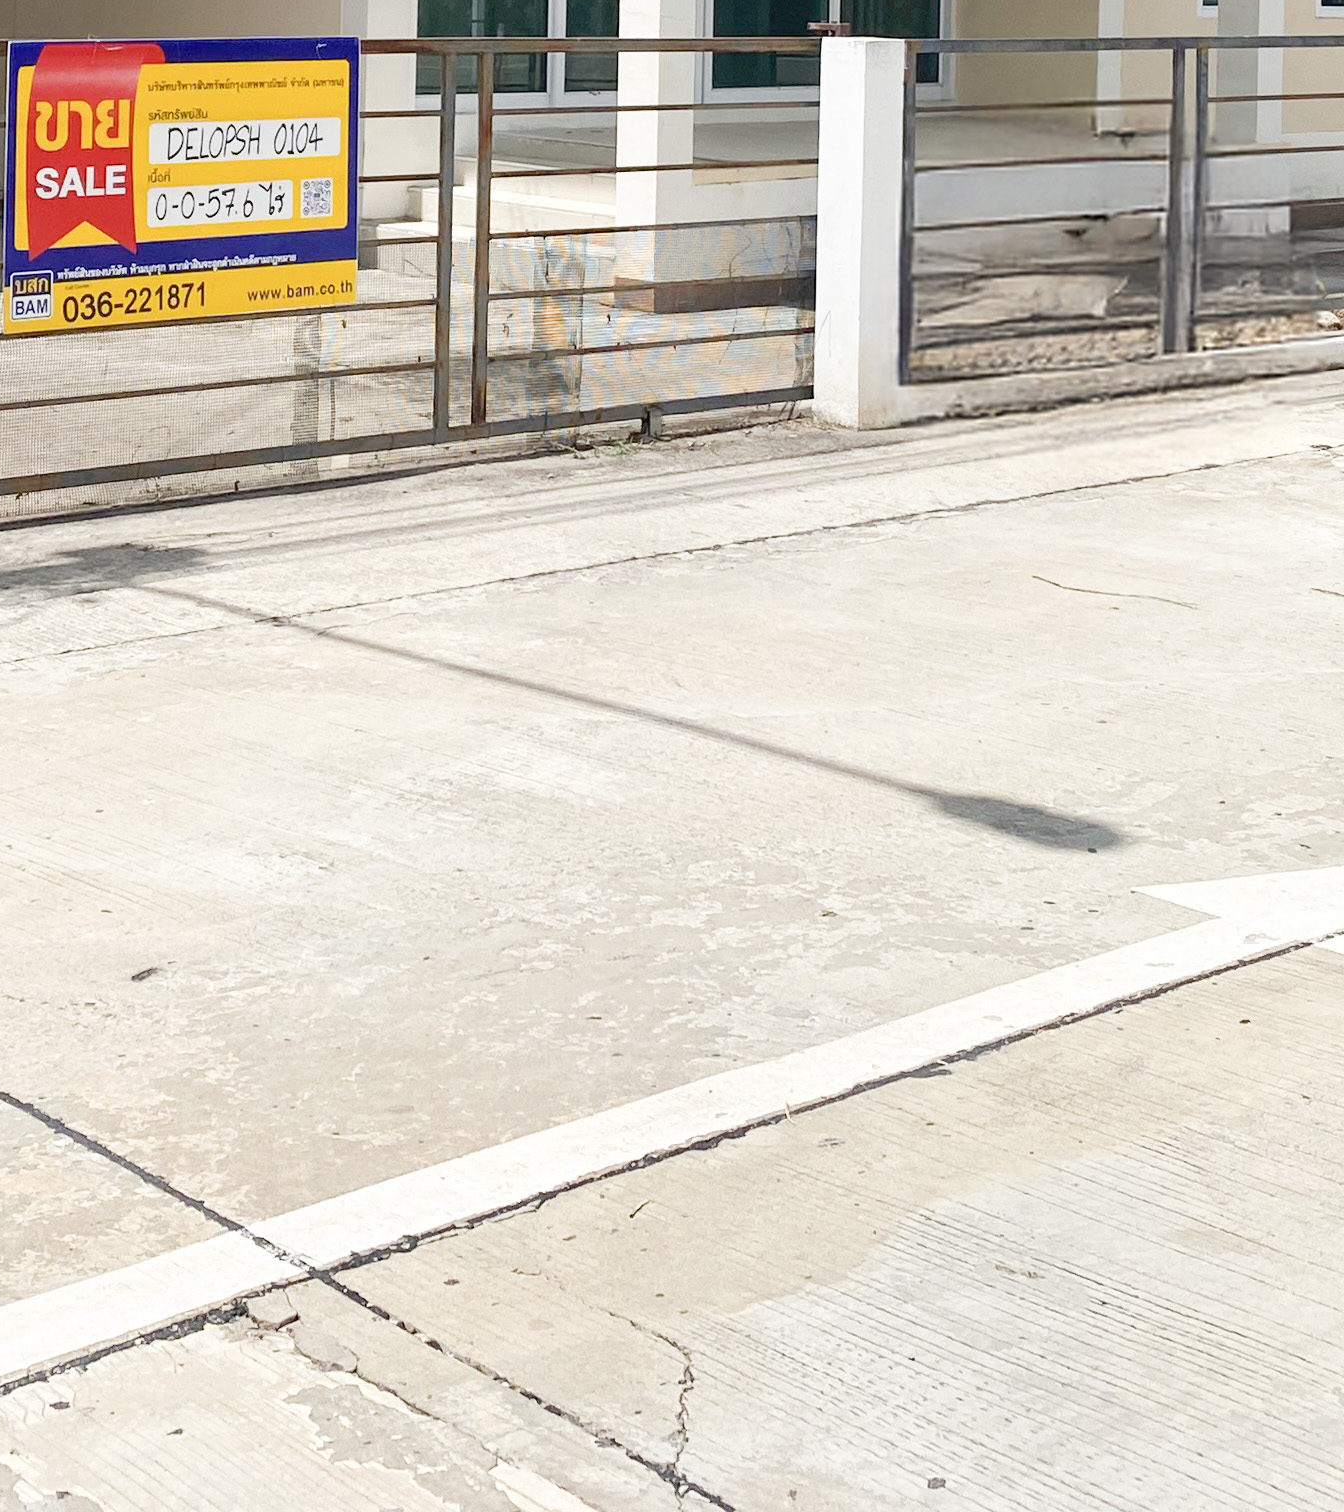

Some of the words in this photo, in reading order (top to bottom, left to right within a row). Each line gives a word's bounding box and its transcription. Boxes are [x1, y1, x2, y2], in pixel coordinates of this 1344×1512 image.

[34, 99, 130, 152] ขาย
[148, 108, 208, 121] รหัสทรัพย์สิน
[273, 123, 324, 157] 0104
[35, 164, 127, 199] SALE
[155, 188, 254, 221] 0-0-57.6
[15, 277, 49, 295] บสก
[248, 281, 353, 303] www.bam.co.th
[15, 298, 49, 316] BAM
[62, 283, 206, 323] 036-221871
